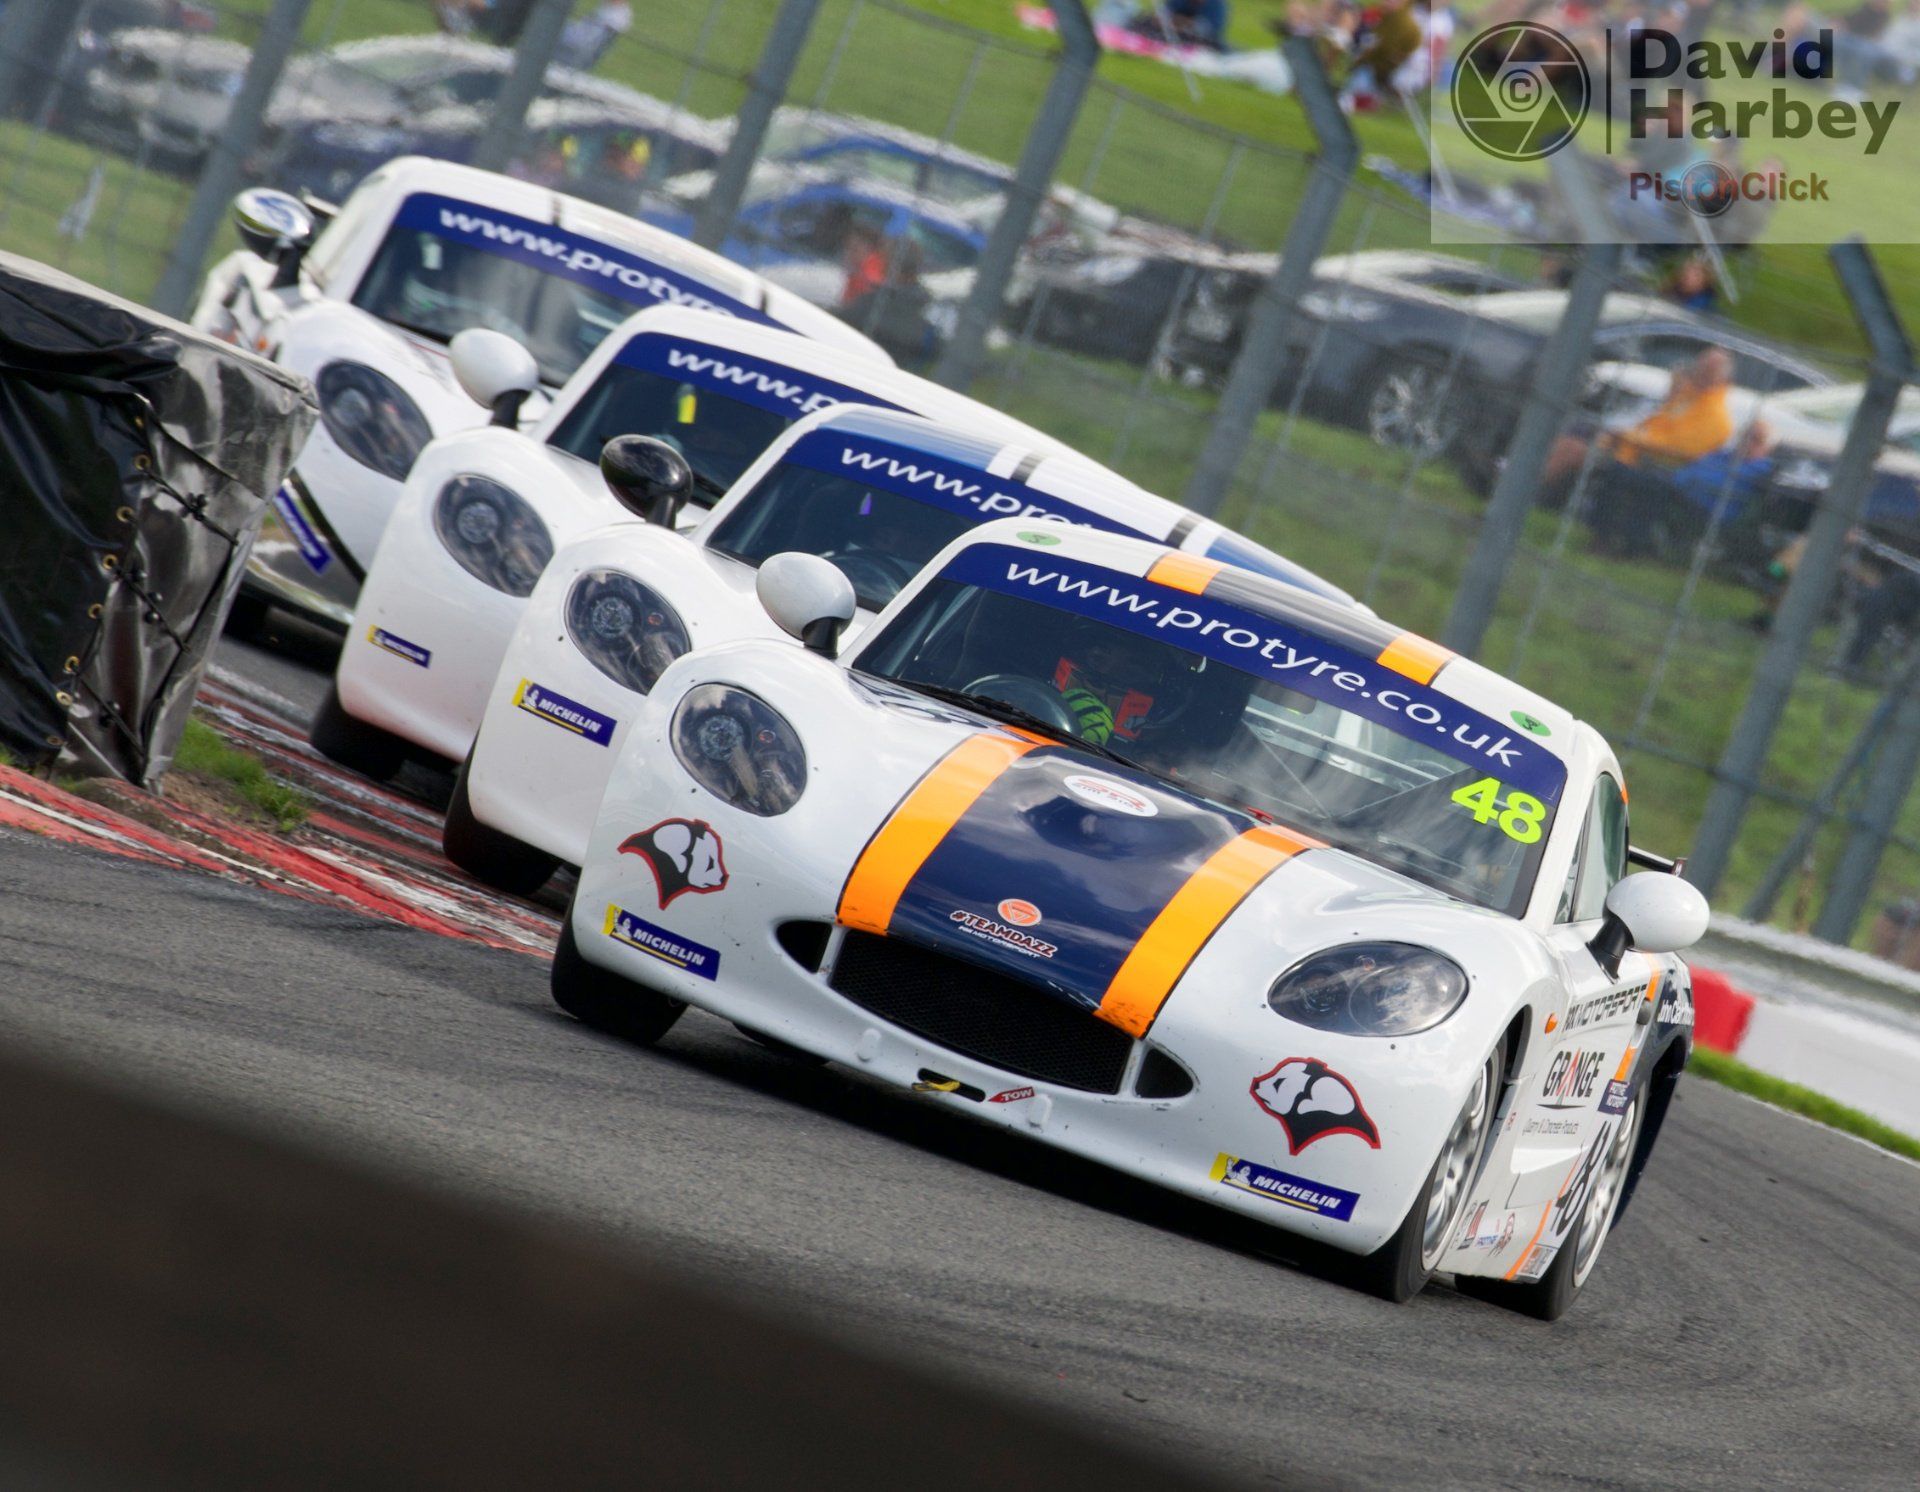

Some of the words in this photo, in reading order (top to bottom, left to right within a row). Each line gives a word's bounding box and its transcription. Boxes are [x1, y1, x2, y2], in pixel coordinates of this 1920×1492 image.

[1005, 562, 1524, 768] www.protyre.co.uk
[538, 698, 602, 733] MICHELIN
[1451, 777, 1546, 844] 48
[633, 928, 706, 966] MICHELIN
[950, 910, 1058, 958] #TEAMDAZZ
[1542, 1047, 1605, 1098] GRANGE
[1001, 1088, 1033, 1101] TOW
[1253, 1175, 1342, 1209] MICHELIN
